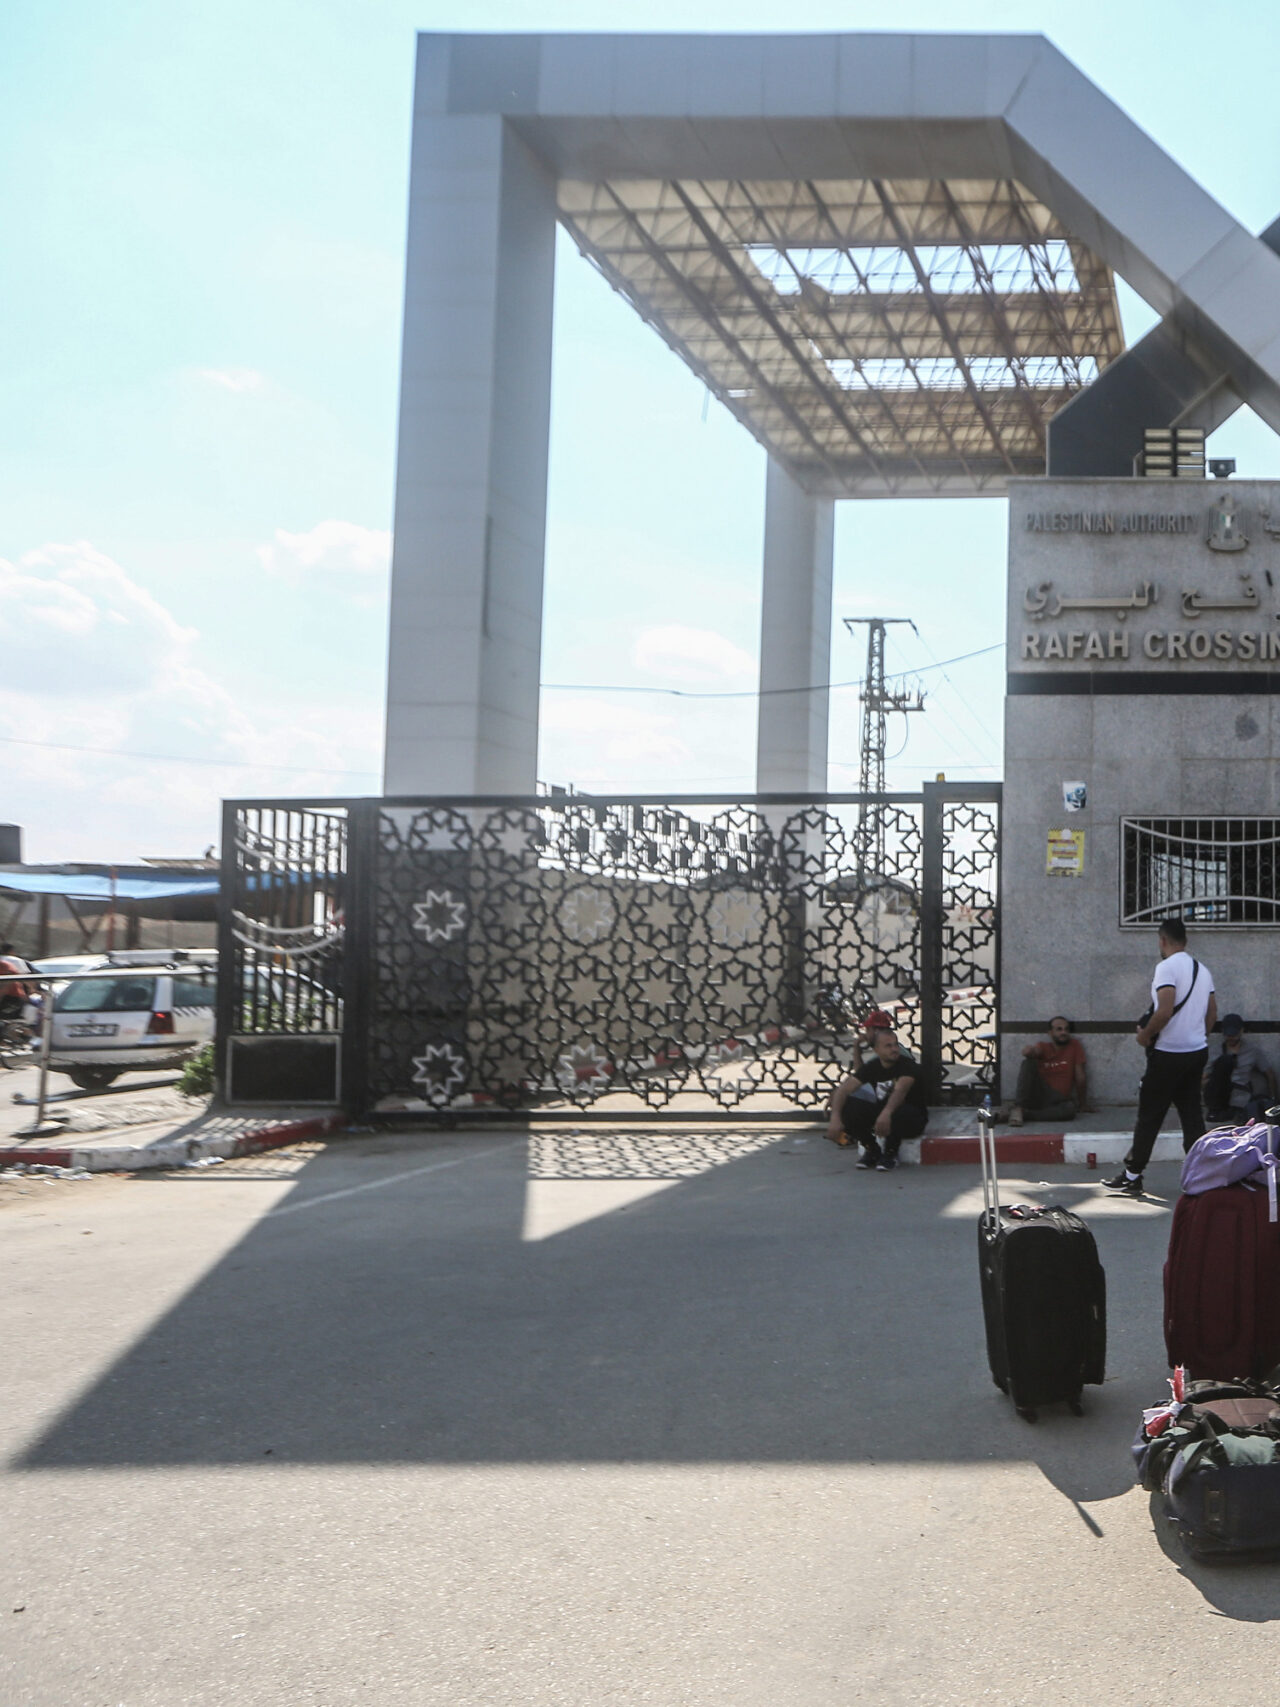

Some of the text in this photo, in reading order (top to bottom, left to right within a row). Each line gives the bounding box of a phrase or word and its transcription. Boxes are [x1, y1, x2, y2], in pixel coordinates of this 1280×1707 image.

[1024, 511, 1199, 533] PALESTINIAN AUTHORITY
[1023, 581, 1160, 620] البري
[1021, 629, 1131, 660] RAFAH
